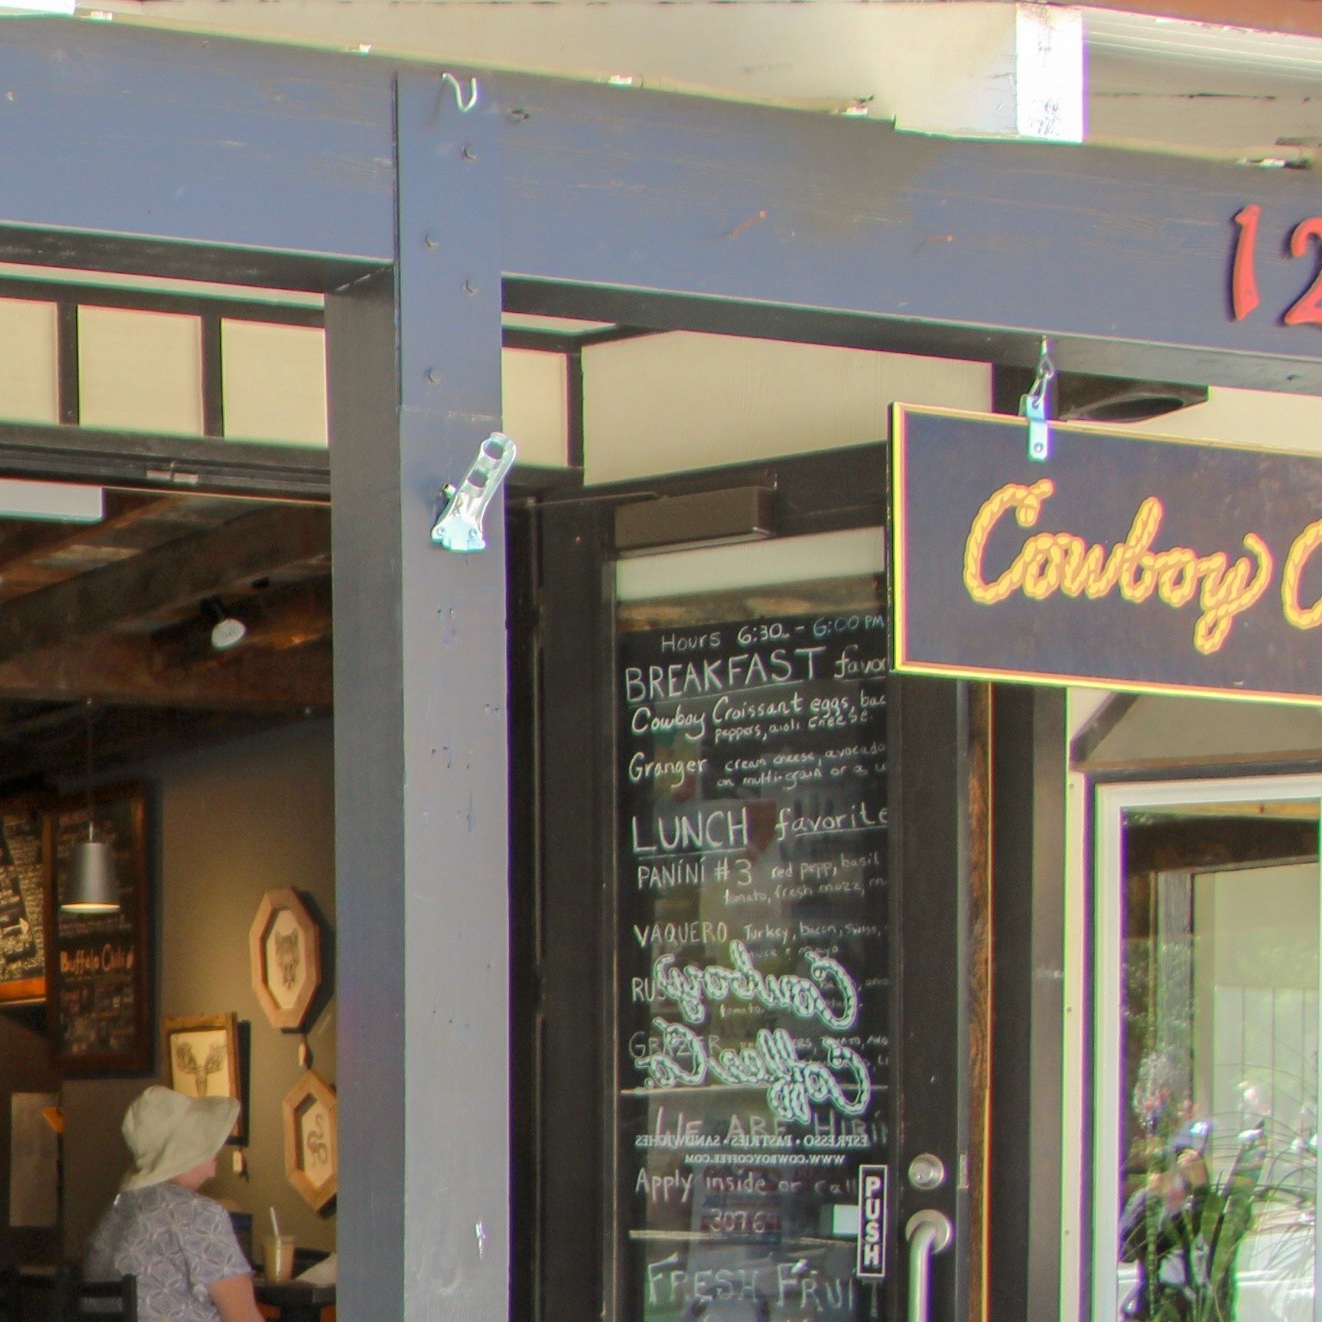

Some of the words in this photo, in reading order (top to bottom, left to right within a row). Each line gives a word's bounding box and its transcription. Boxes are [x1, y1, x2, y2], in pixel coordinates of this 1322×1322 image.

[964, 478, 1272, 655] Cowboy
[661, 630, 721, 652] Hours
[813, 615, 859, 638] 6:00
[624, 646, 826, 703] BREAKFAST
[631, 704, 705, 740] Cowboy
[712, 691, 803, 723] Croissant
[628, 751, 707, 788] Granger
[631, 807, 748, 853] LUNCH
[633, 921, 728, 948] VAQUERO
[635, 1166, 694, 1203] Apply
[705, 1168, 768, 1195] inside
[863, 1176, 883, 1268] PUSH
[647, 1252, 759, 1306] FRESH
